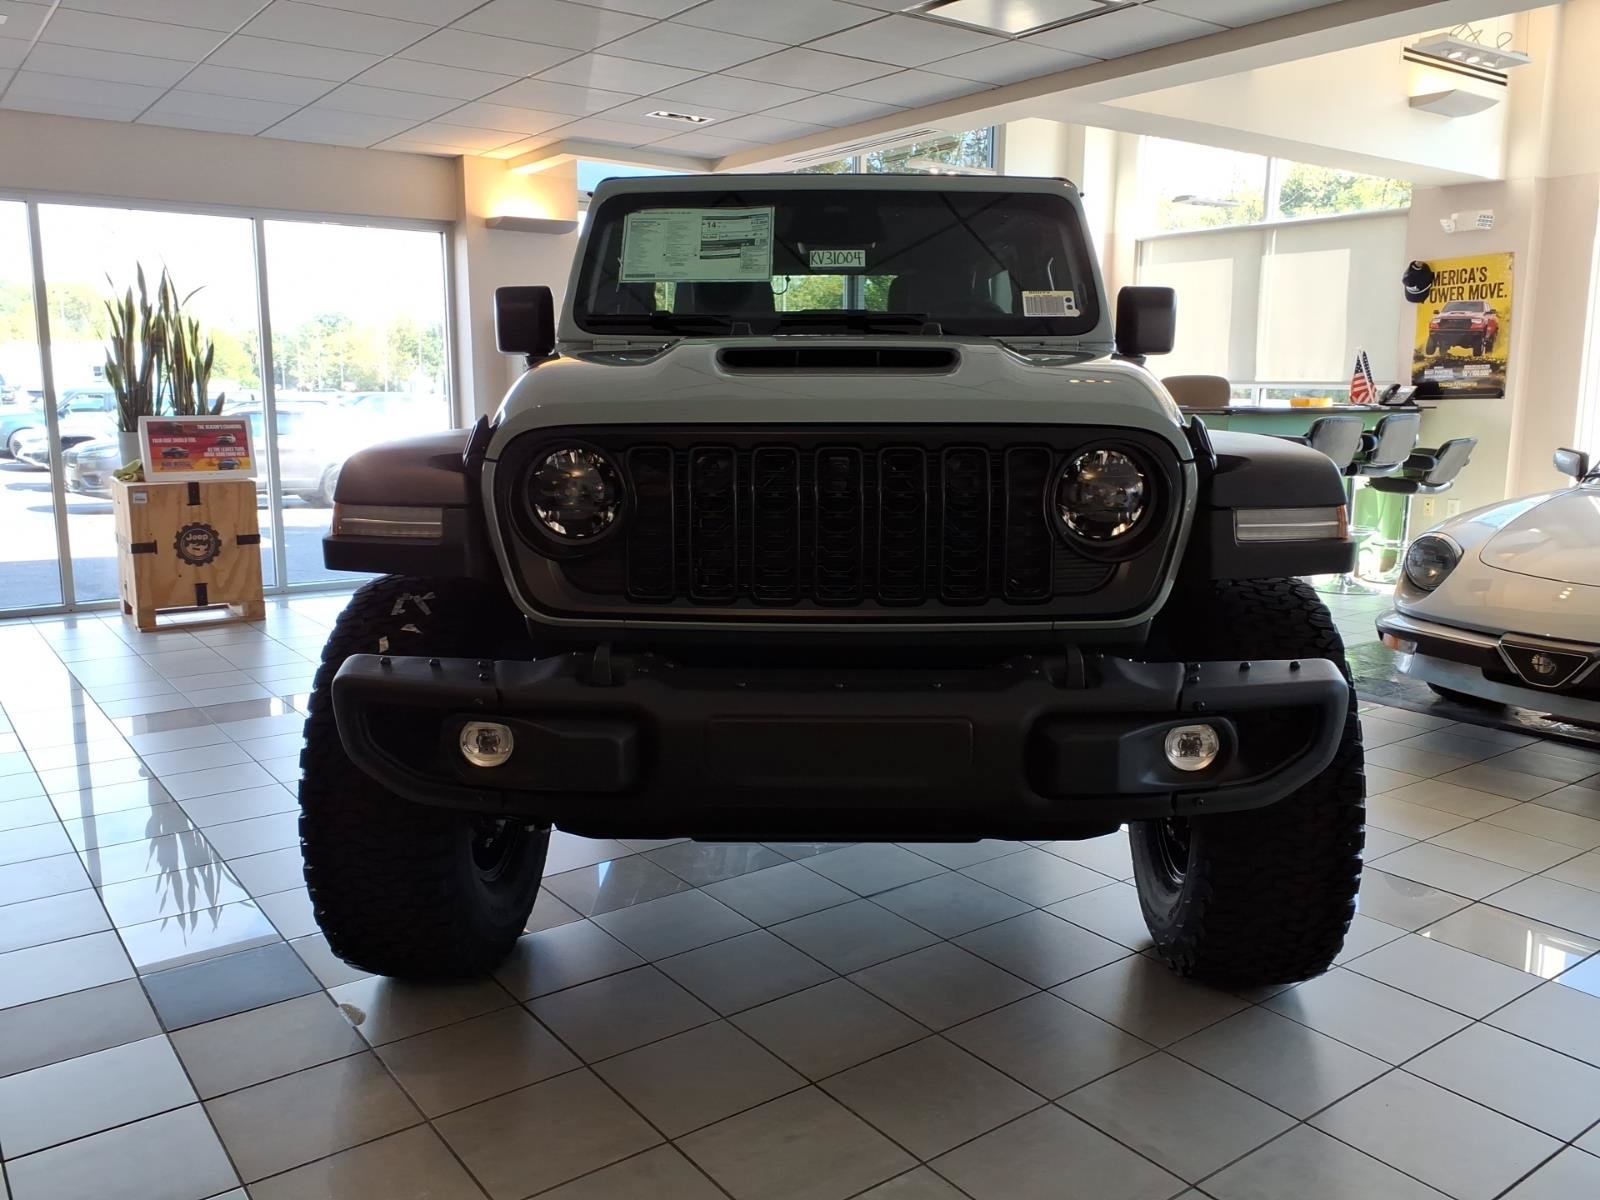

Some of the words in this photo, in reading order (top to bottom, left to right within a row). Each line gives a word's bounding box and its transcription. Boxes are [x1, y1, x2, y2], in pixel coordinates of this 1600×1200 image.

[811, 251, 863, 266] KV31004
[1431, 266, 1488, 287] MERICA'S
[1429, 286, 1465, 304] OWER
[1468, 282, 1508, 302] MOVE.
[185, 533, 209, 541] Jeep
